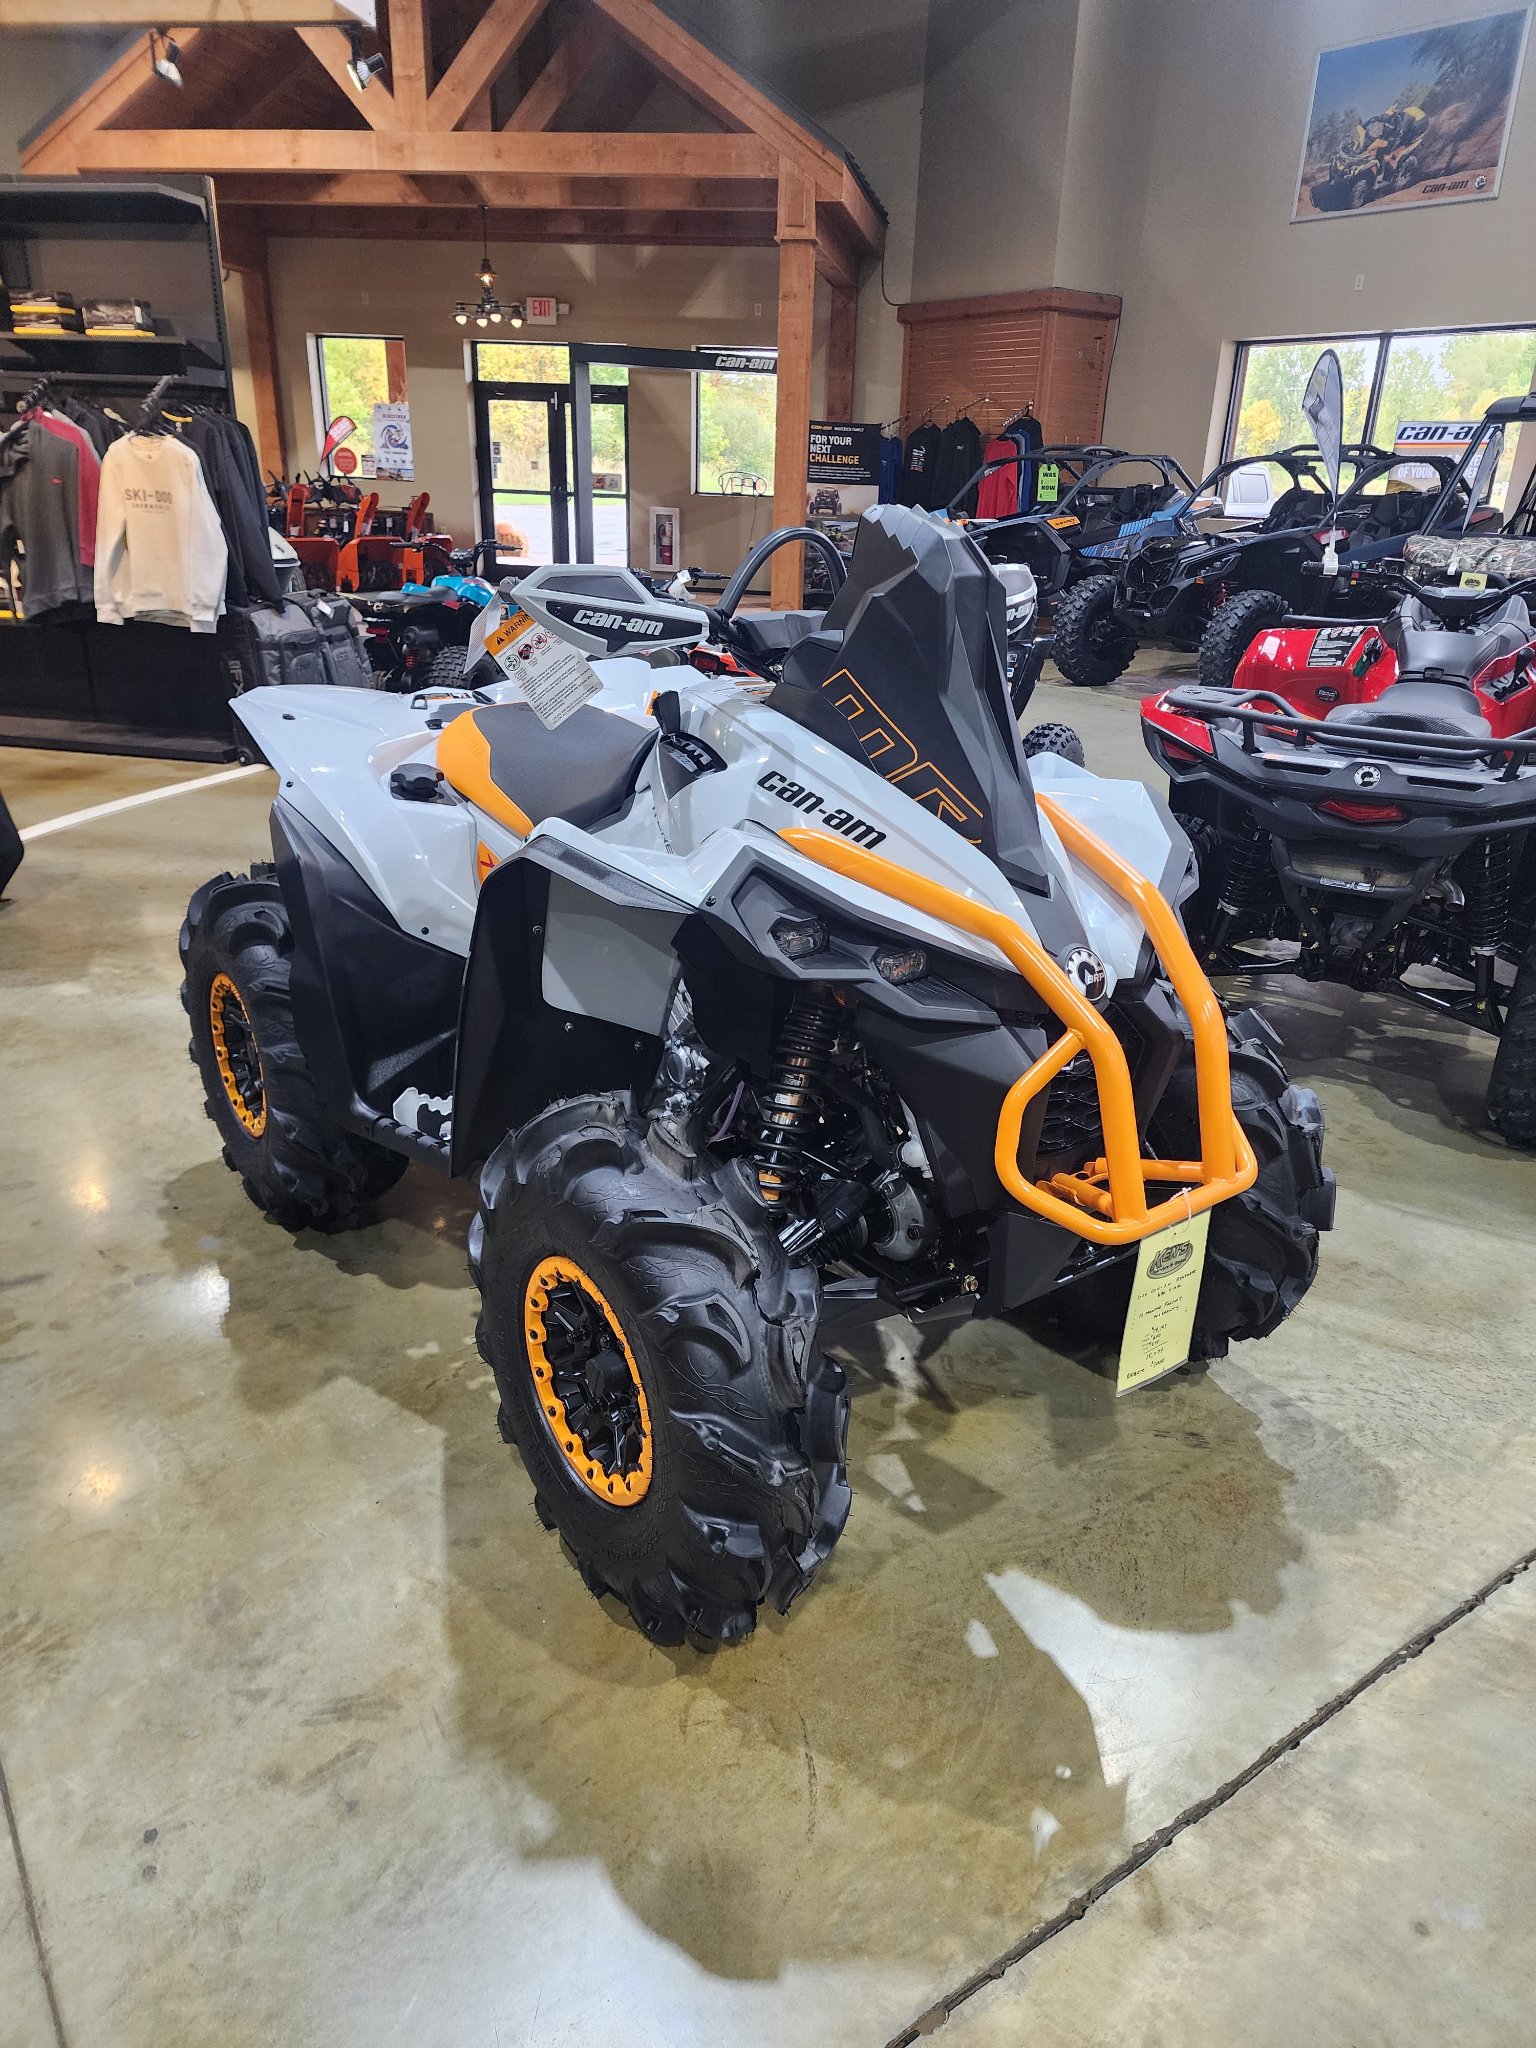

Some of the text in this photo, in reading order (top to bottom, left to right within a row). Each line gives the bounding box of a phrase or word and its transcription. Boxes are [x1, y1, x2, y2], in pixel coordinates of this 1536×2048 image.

[1422, 179, 1470, 194] can-am
[532, 300, 551, 317] EXIT
[715, 355, 776, 370] can-am
[810, 434, 853, 446] FOR YOUR
[810, 444, 832, 454] NEXT
[809, 453, 860, 465] CHALLENGE
[1397, 466, 1409, 479] OF
[1411, 466, 1433, 479] YOUR
[503, 613, 531, 637] WARNIN
[572, 608, 664, 637] can-am
[756, 770, 887, 851] can-am
[1087, 972, 1105, 985] BRP
